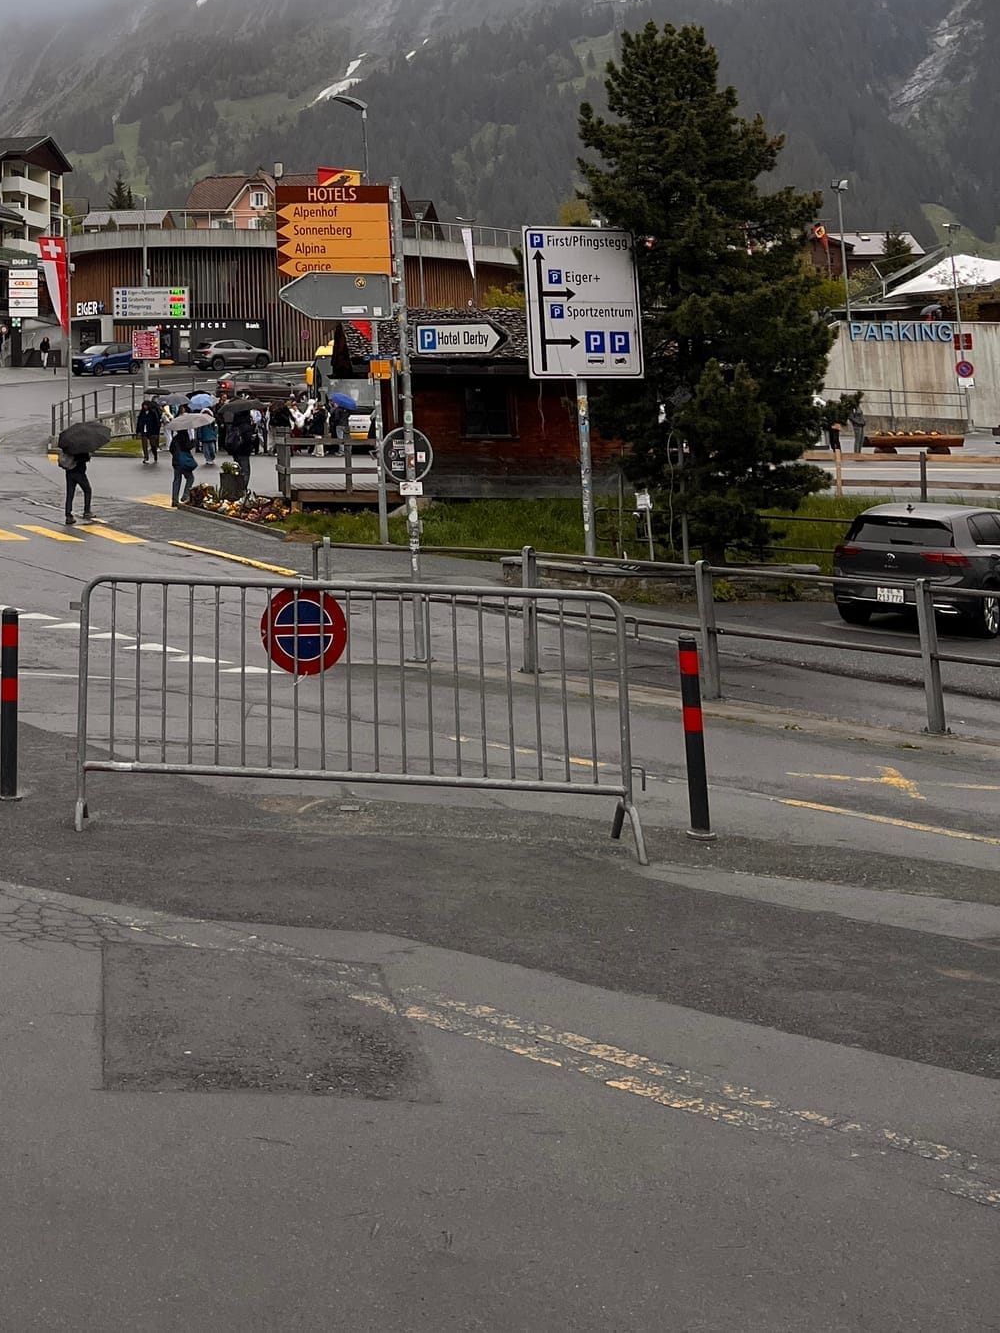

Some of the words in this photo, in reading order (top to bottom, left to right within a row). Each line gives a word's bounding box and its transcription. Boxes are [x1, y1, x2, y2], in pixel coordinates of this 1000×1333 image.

[308, 187, 357, 201] HOTELS
[293, 206, 338, 220] Alpenhof
[293, 224, 352, 238] Sonnenberg
[295, 243, 326, 256] Alpina
[547, 235, 628, 251] First/Pfingstegg
[295, 261, 331, 272] Caprice
[565, 271, 600, 285] Eiger+
[567, 306, 633, 320] Sportzentrum
[438, 331, 460, 345] Hotel
[463, 331, 489, 347] Derby
[850, 322, 953, 342] PARKING
